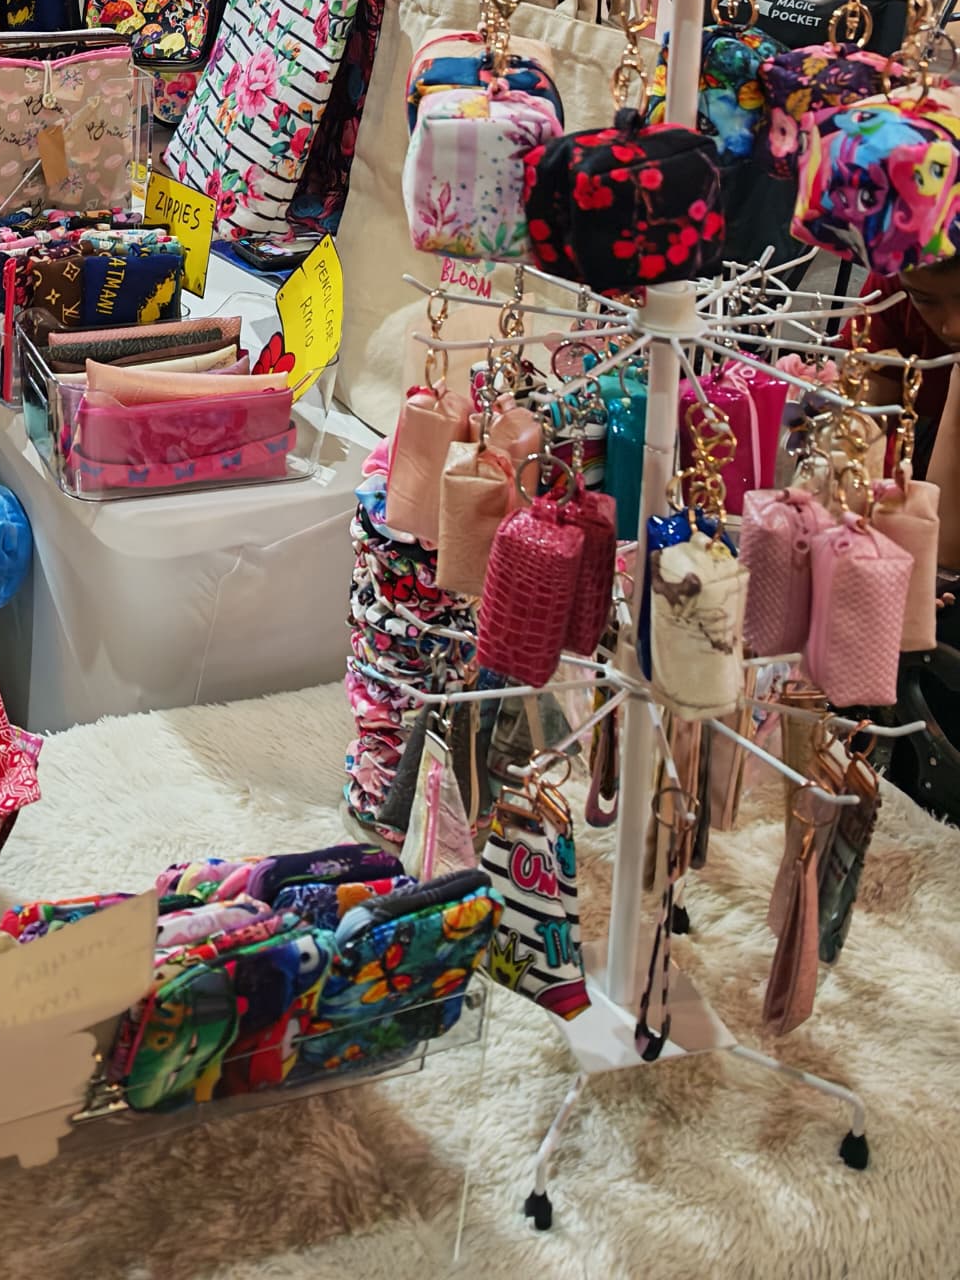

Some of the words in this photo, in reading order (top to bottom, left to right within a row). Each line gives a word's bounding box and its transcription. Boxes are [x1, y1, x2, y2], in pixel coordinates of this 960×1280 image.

[770, 9, 822, 28] POCKET
[155, 191, 201, 230] ZIPPIES
[95, 255, 128, 315] ATMAN!
[441, 256, 492, 299] BLOOM
[314, 259, 332, 309] PENCIL
[324, 309, 335, 343] CASE
